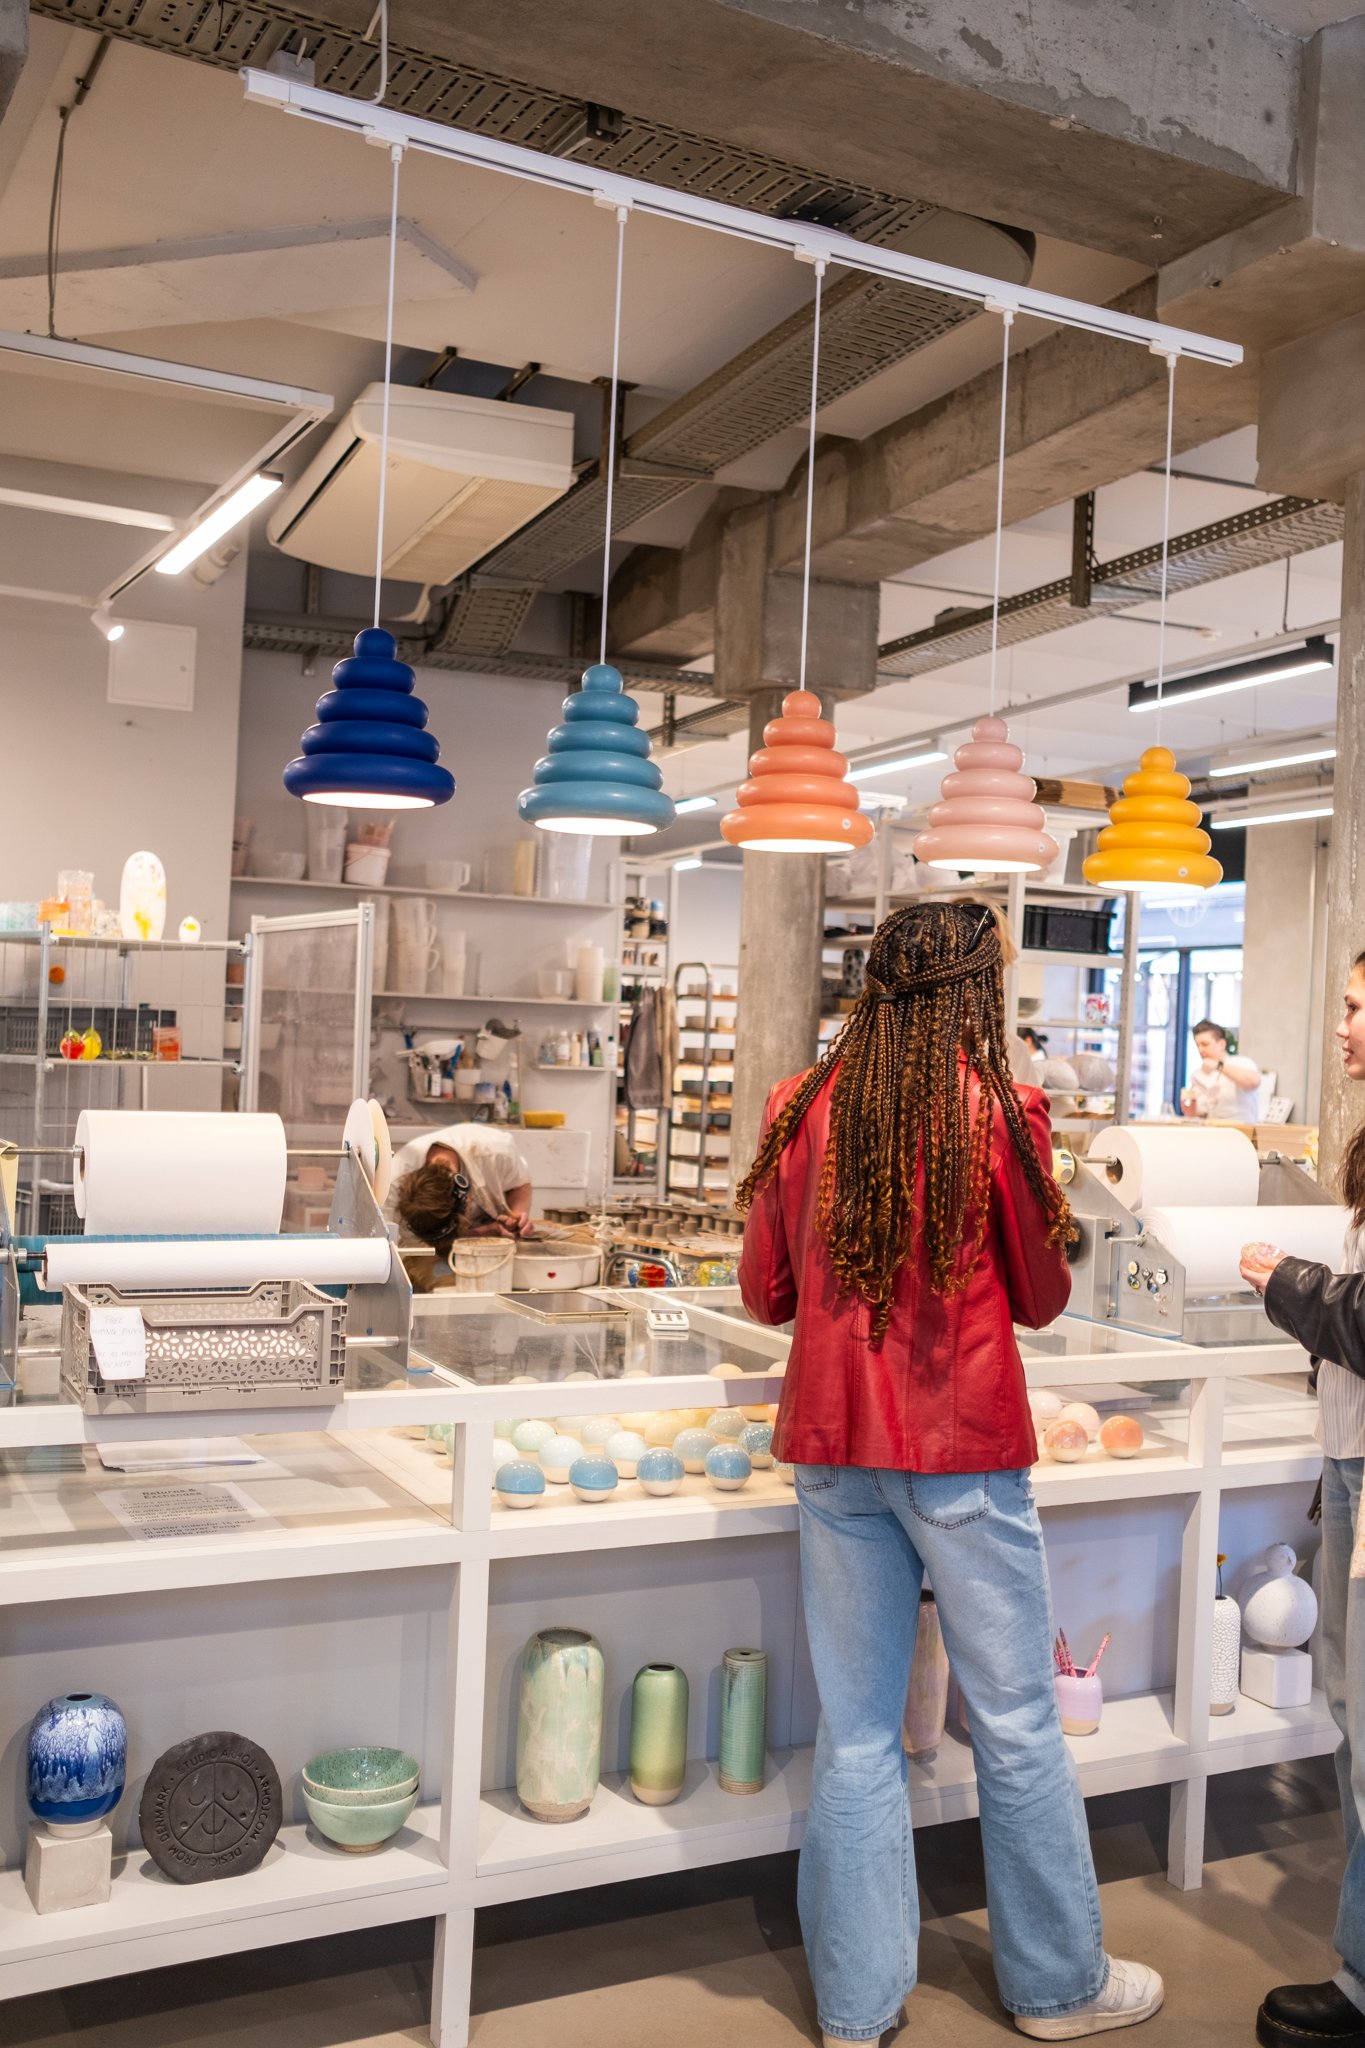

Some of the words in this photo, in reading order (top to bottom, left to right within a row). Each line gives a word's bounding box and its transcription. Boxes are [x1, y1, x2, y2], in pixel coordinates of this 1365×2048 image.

[176, 1748, 218, 1774] STUDIO
[220, 1750, 256, 1769] ARHOJ
[154, 1785, 171, 1842] DENMARK
[168, 1844, 199, 1866] FROM
[206, 1846, 243, 1867] DESIG
